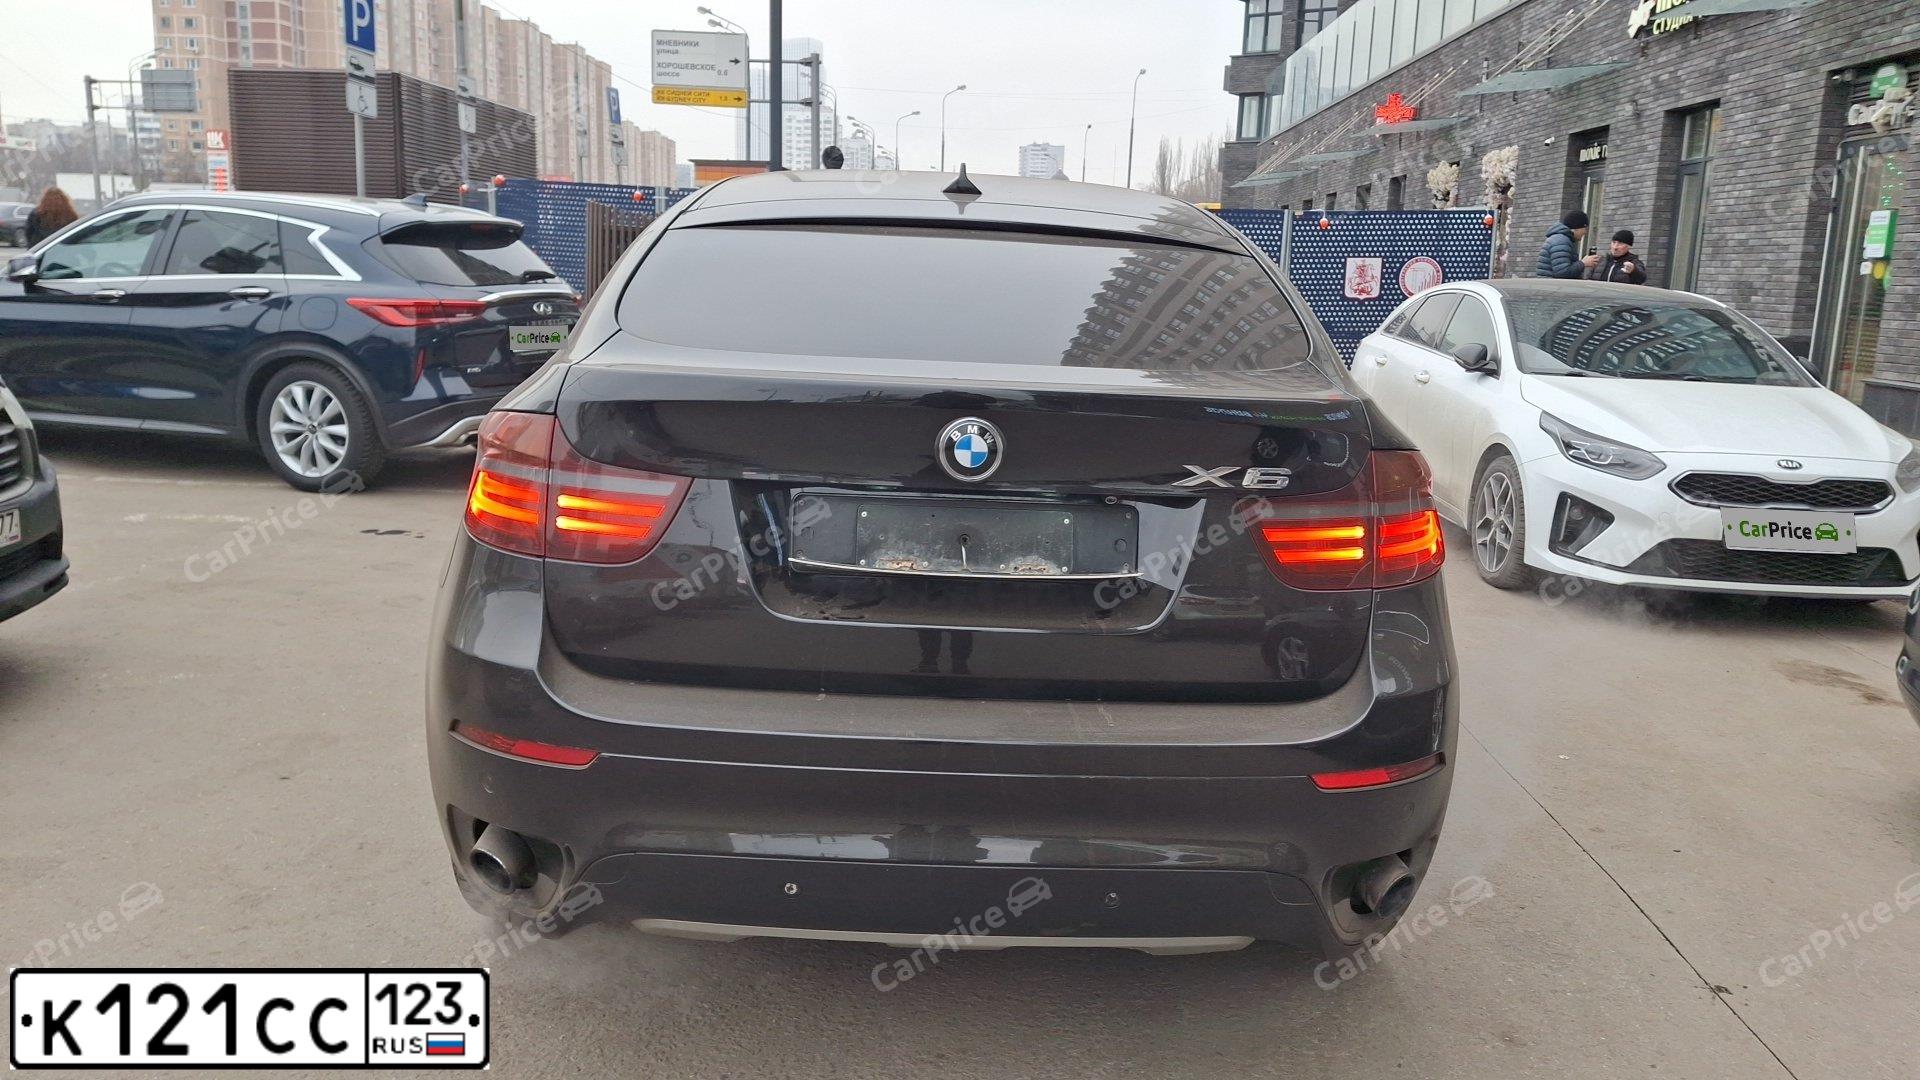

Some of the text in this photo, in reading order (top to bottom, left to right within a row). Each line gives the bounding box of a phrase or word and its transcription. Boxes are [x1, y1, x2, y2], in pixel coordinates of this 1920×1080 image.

[352, 0, 370, 41] P
[656, 39, 699, 47] МНЕВНИКИ
[656, 62, 716, 71] ХОРОШЕВСКОЕ
[950, 425, 994, 443] BMW
[1780, 460, 1801, 469] KIA
[1171, 464, 1292, 489] X6
